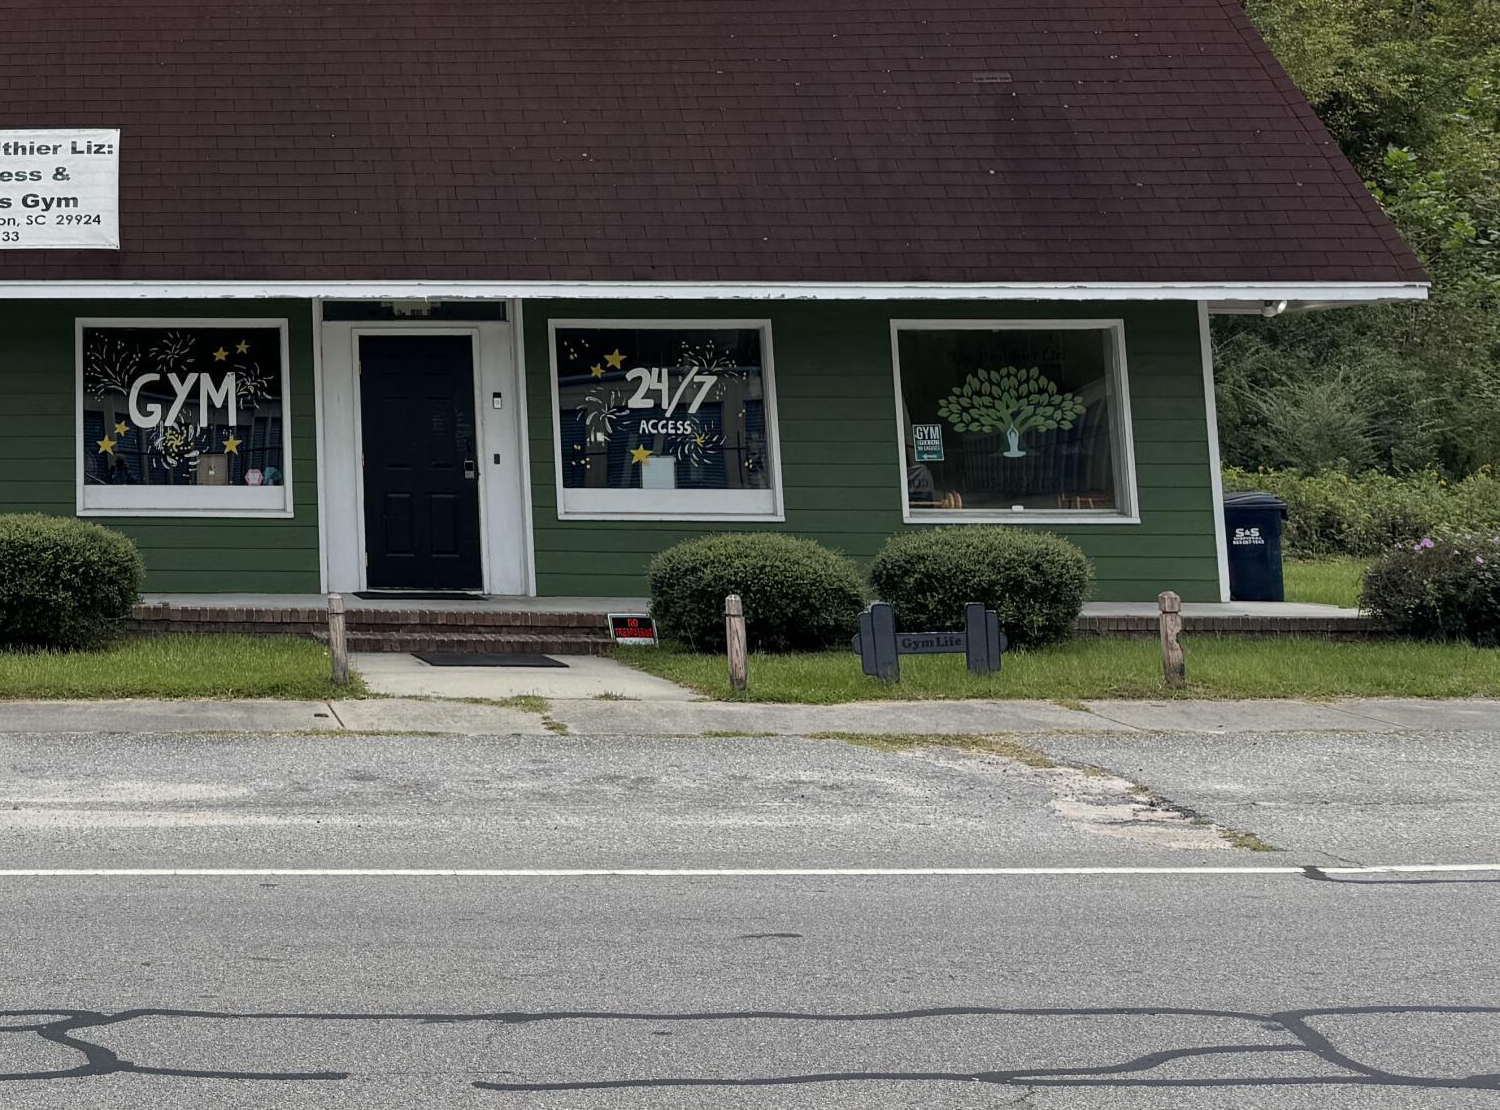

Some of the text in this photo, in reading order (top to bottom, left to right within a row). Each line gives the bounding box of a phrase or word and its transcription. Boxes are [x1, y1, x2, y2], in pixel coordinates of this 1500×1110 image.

[71, 141, 113, 155] Liz:
[52, 166, 71, 181] &
[22, 193, 78, 211] Gym
[26, 214, 46, 225] SC
[56, 214, 101, 225] 29924
[625, 366, 718, 418] 24/7
[128, 371, 237, 428] GYM
[639, 420, 692, 435] ACCESS
[916, 426, 940, 439] GYM
[627, 618, 639, 627] NO
[901, 637, 962, 650] Gym Life
